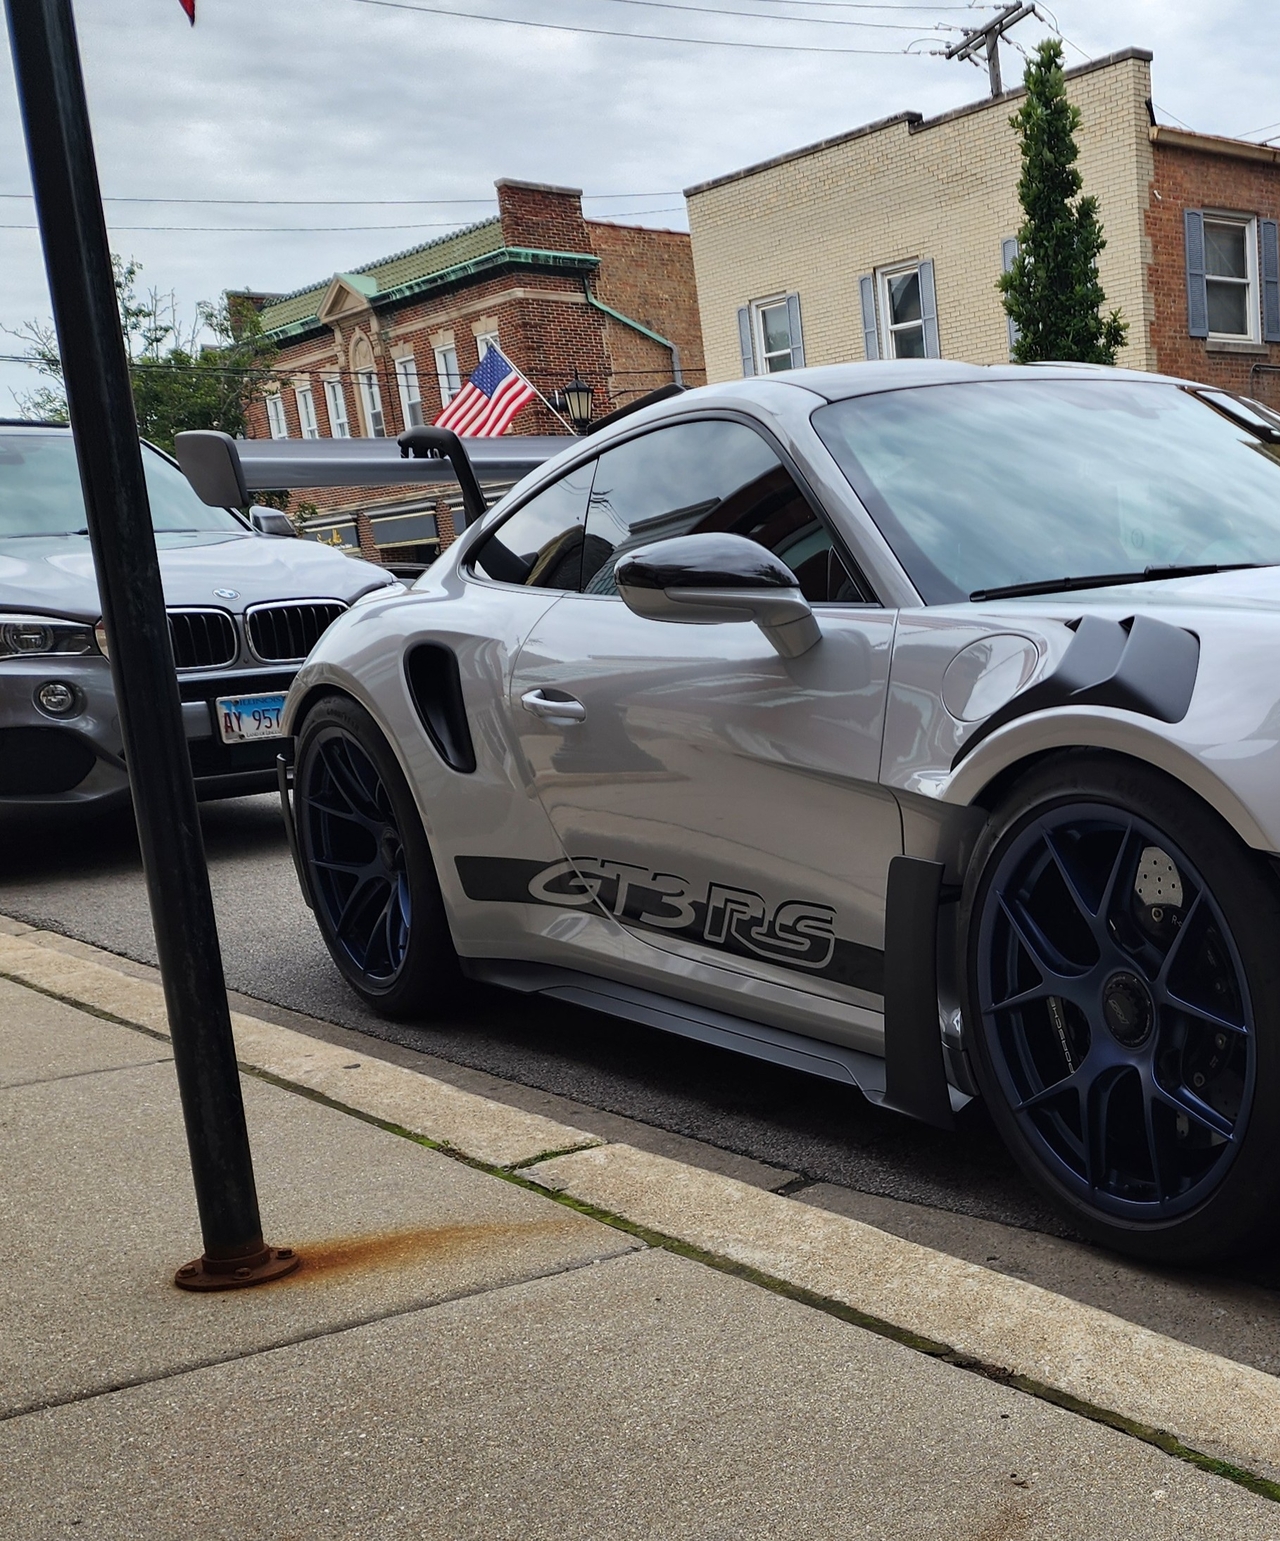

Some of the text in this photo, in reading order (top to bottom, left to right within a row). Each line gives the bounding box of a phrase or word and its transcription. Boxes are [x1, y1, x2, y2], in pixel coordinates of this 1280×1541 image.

[223, 711, 242, 733] AY
[528, 856, 838, 969] GT3 RS
